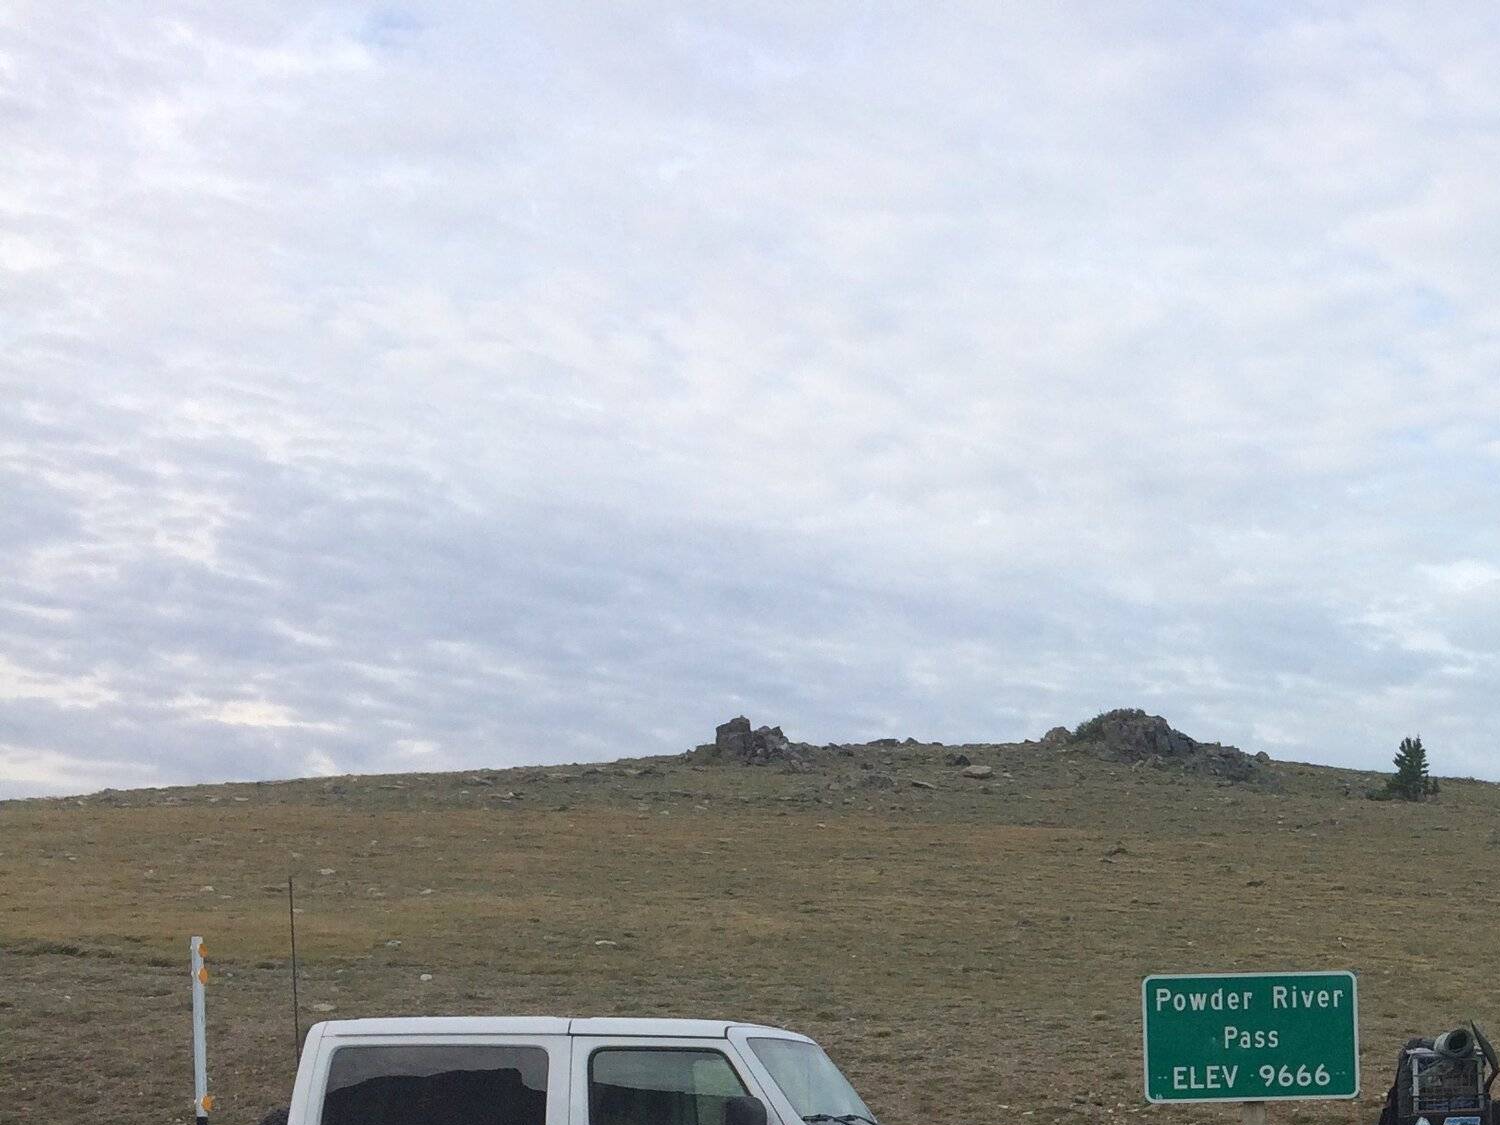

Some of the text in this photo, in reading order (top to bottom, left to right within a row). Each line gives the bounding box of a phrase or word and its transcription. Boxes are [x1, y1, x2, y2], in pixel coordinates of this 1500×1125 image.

[1156, 985, 1344, 1011] Powder River
[1224, 1026, 1279, 1049] Pass
[1173, 1063, 1330, 1089] ELEV 9666
